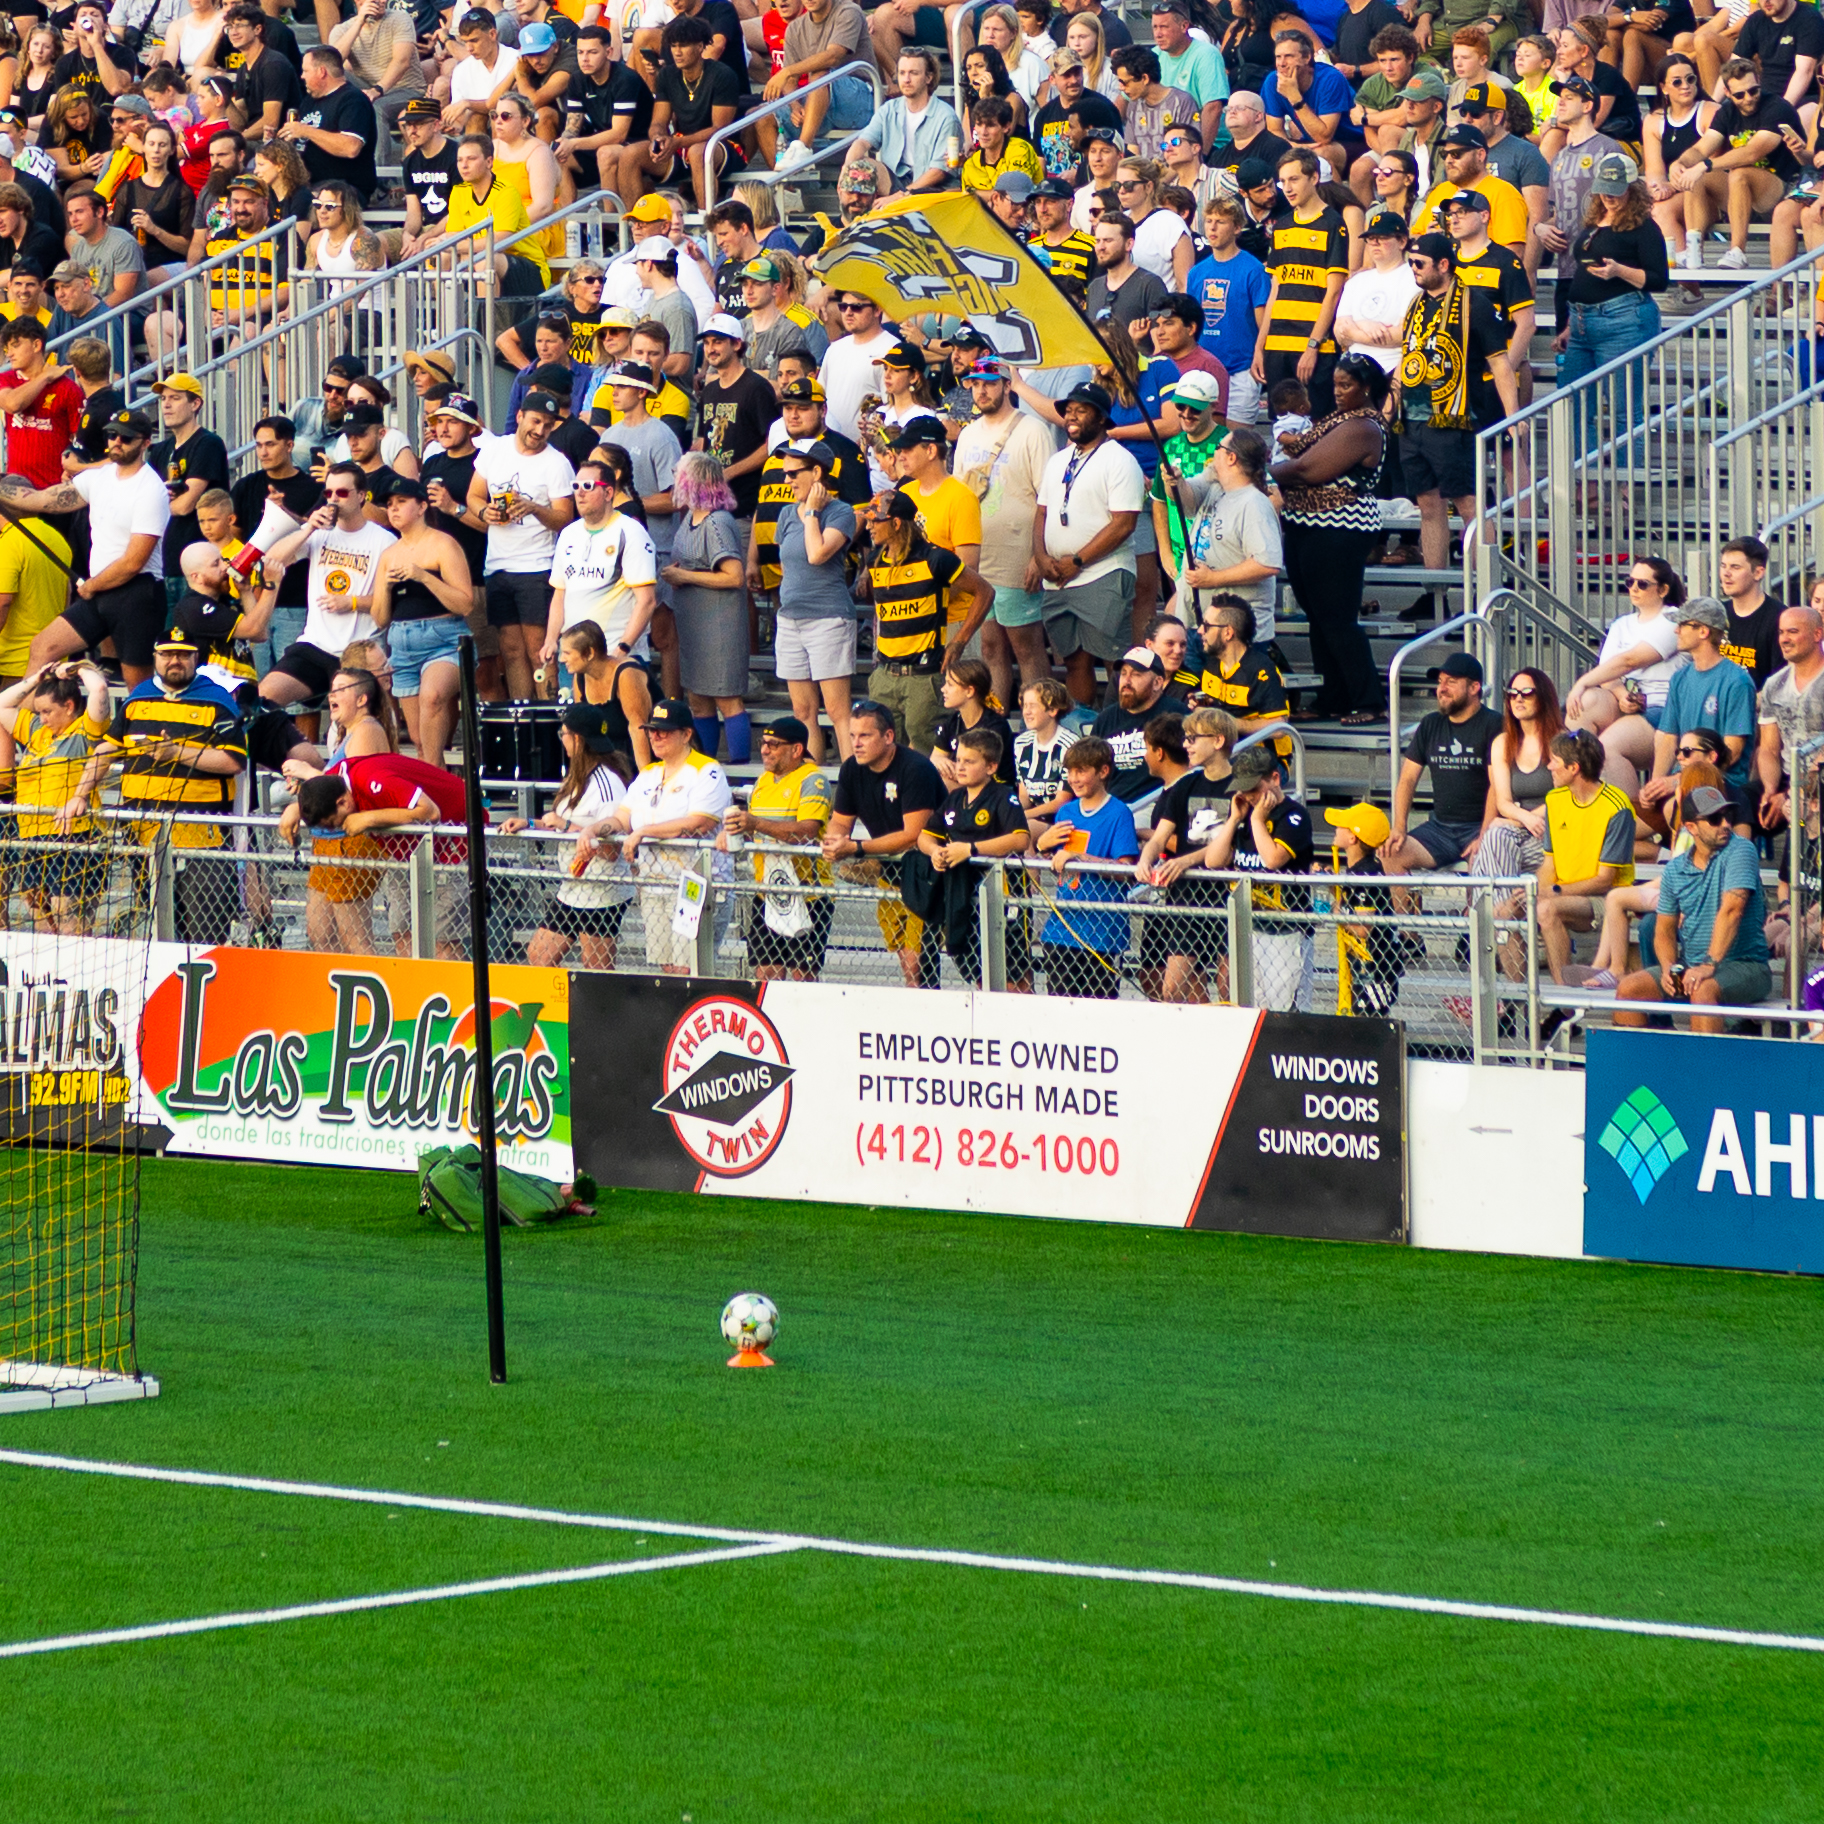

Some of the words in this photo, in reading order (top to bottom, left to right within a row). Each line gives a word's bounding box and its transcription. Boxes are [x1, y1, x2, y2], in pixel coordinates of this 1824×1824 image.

[1288, 269, 1314, 281] AHN
[578, 567, 605, 579] AHN
[889, 602, 919, 616] AHN
[1430, 755, 1482, 765] HITCHHIKER
[167, 960, 307, 1117] Las
[318, 970, 558, 1139] Palmas
[673, 1009, 765, 1073] THERMO
[859, 1032, 1001, 1067] EMPLOYEE
[1011, 1041, 1119, 1074] OWNED
[30, 1071, 98, 1106] 92.9FM
[104, 1076, 132, 1104] HD2
[679, 1066, 773, 1110] WINDOWS
[1271, 1054, 1379, 1086] WINDOWS
[859, 1074, 1023, 1111] PITTSBURGH
[1035, 1086, 1119, 1118] MADE
[1304, 1094, 1380, 1123] DOORS
[197, 1117, 258, 1146] donde
[266, 1121, 291, 1147] las
[299, 1123, 405, 1156] tradiciones
[414, 1140, 433, 1157] se
[707, 1118, 770, 1163] TWIN
[856, 1122, 943, 1171] (412)
[957, 1128, 1120, 1177] 826-1000
[1258, 1127, 1381, 1161] SUNROOMS
